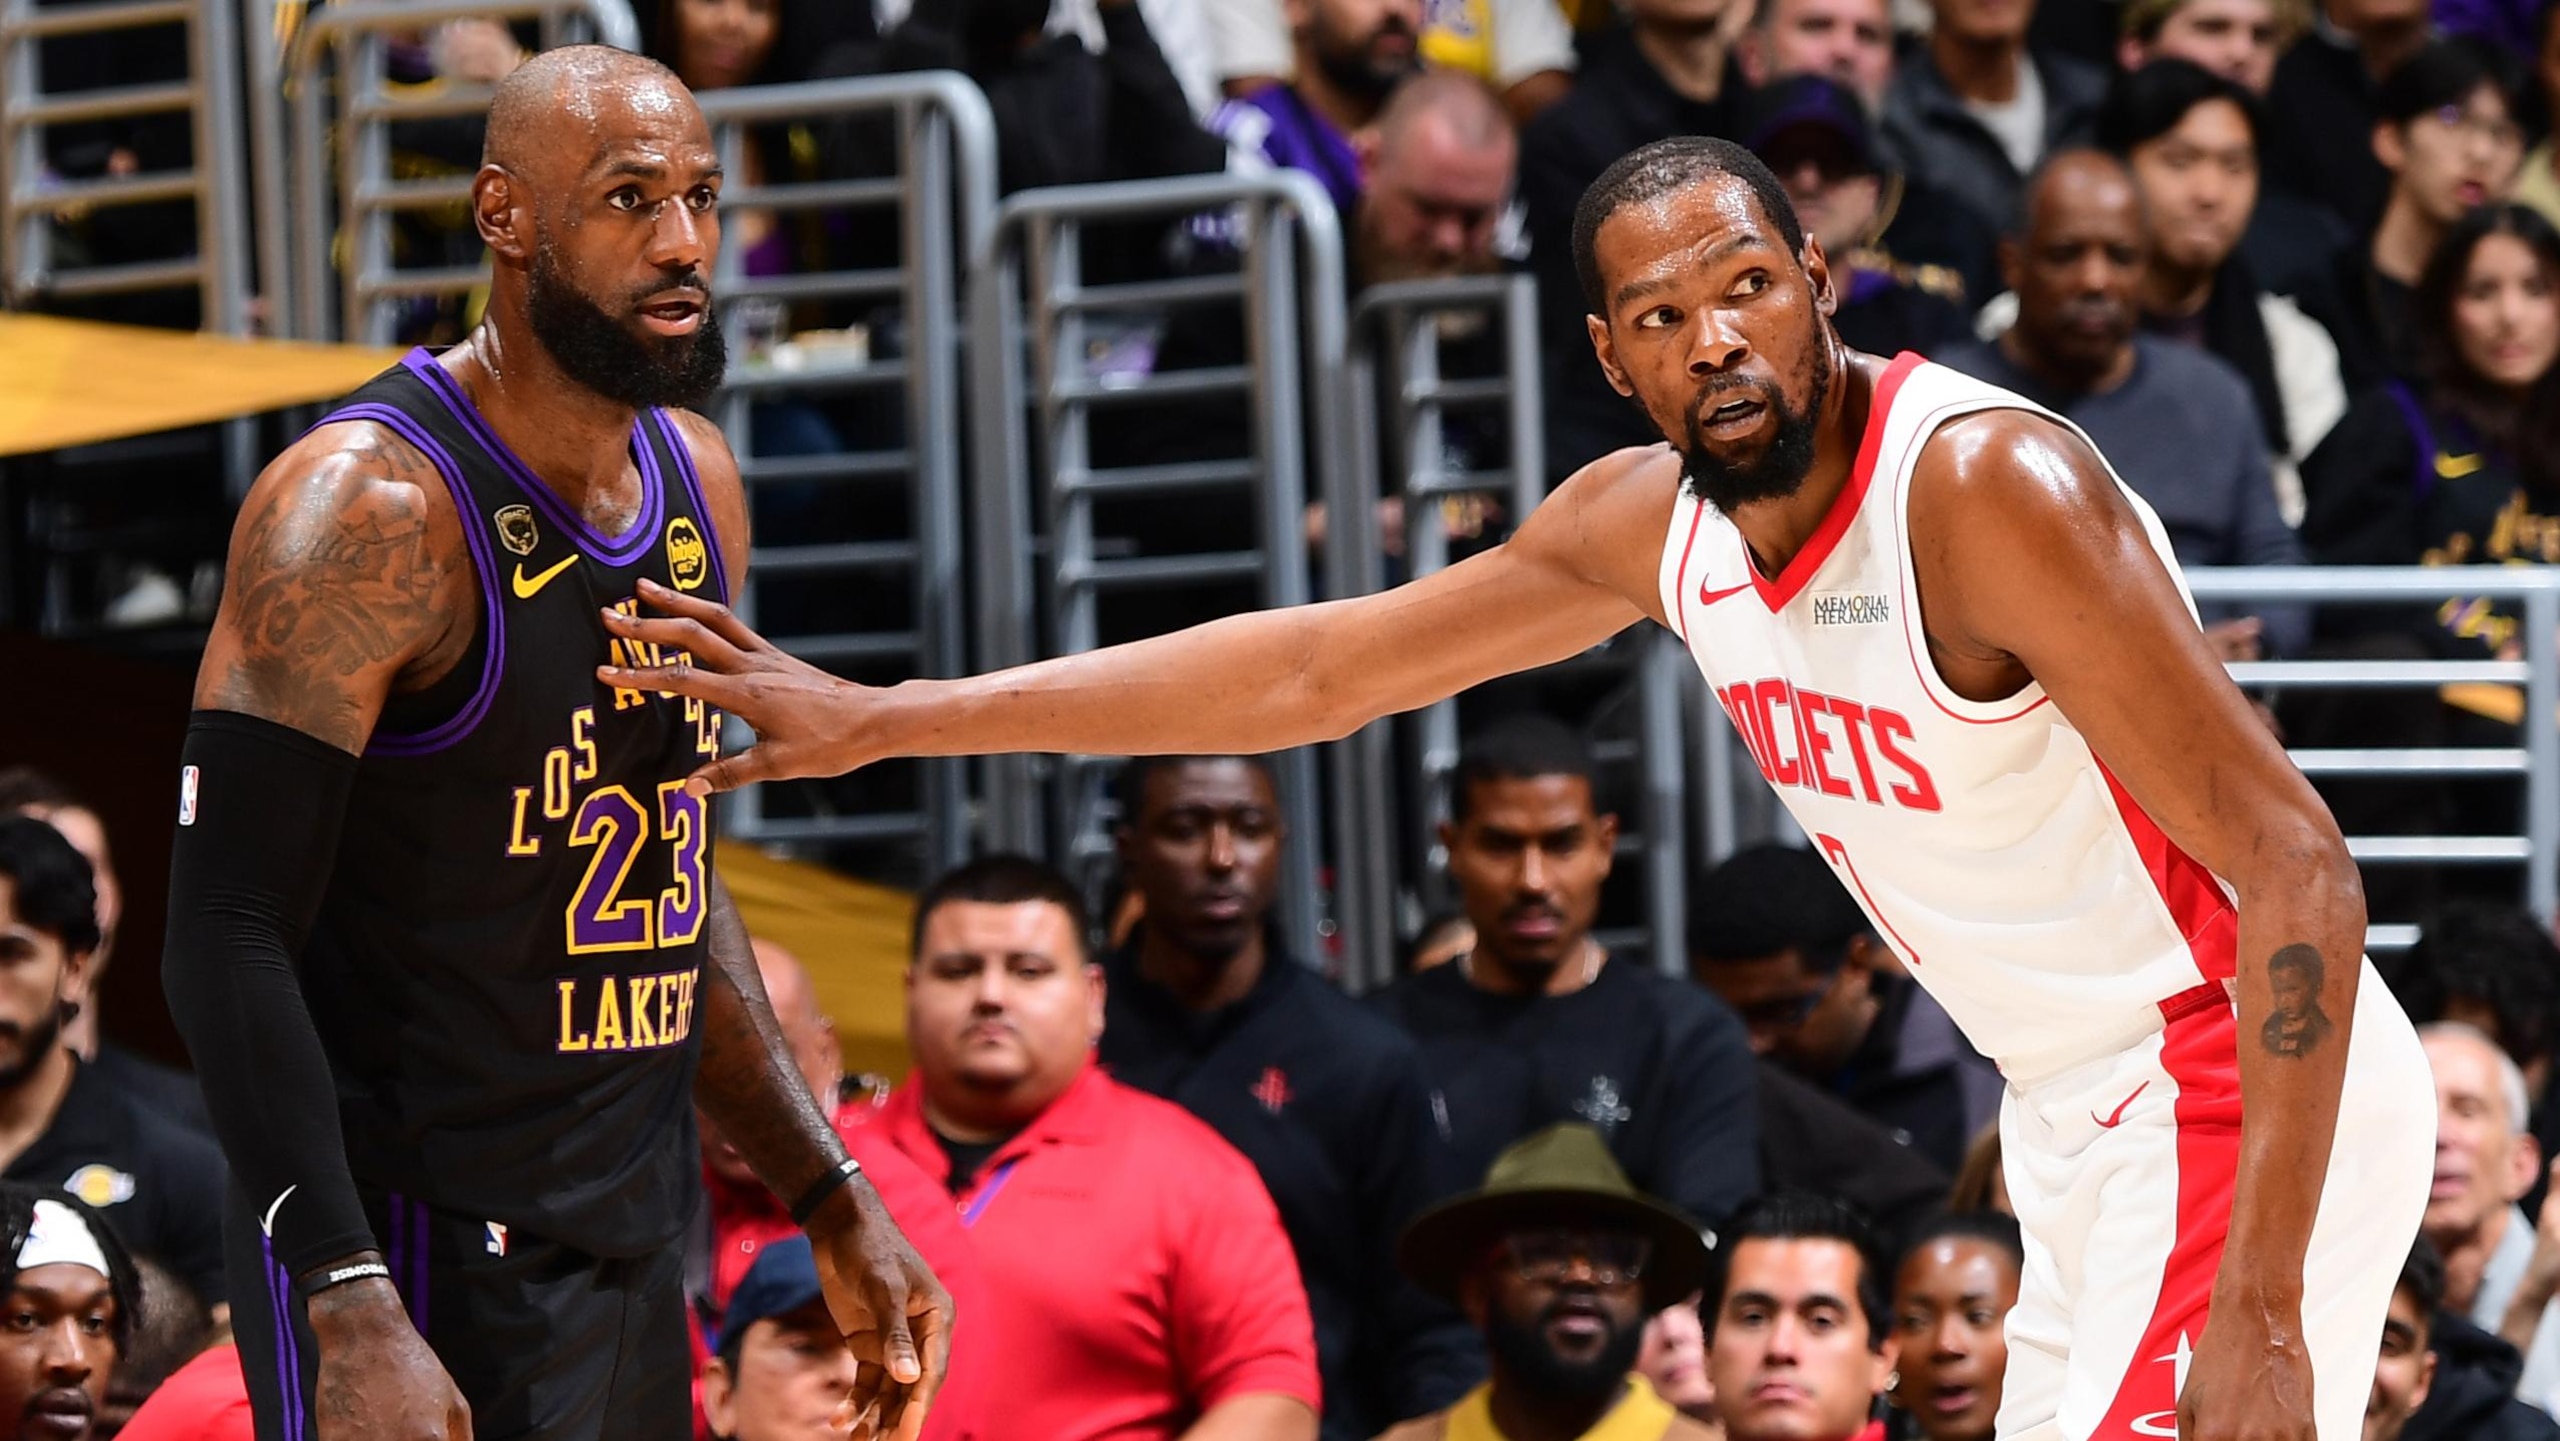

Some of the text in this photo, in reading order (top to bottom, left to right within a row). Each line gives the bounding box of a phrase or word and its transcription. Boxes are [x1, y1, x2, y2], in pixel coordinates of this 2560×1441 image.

[1814, 595, 1889, 612] MEMORIAL
[1814, 609, 1889, 625] HERMANN
[506, 706, 598, 857] LOS
[565, 778, 708, 955] 23
